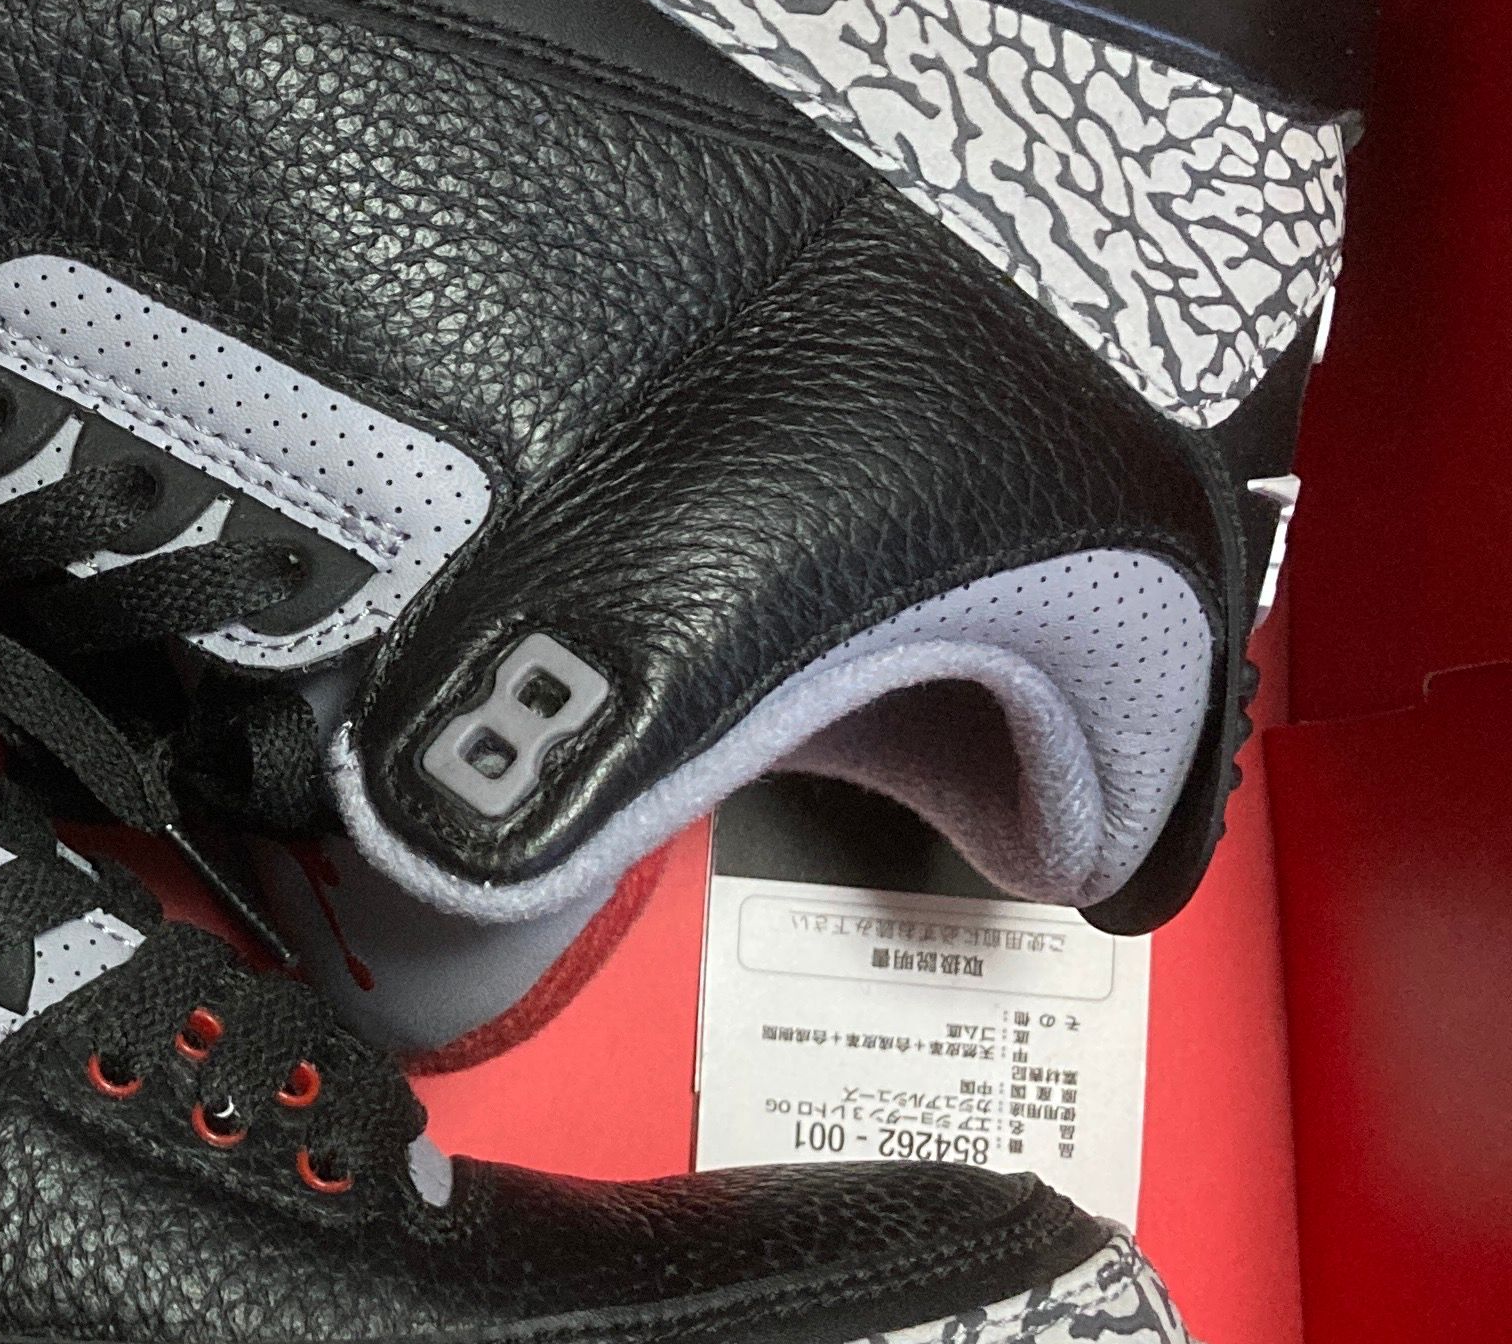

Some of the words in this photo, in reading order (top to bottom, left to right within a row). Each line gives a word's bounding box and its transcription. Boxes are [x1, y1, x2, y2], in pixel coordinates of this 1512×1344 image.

[872, 948, 983, 977] 取扱説明書
[765, 1098, 791, 1114] OG
